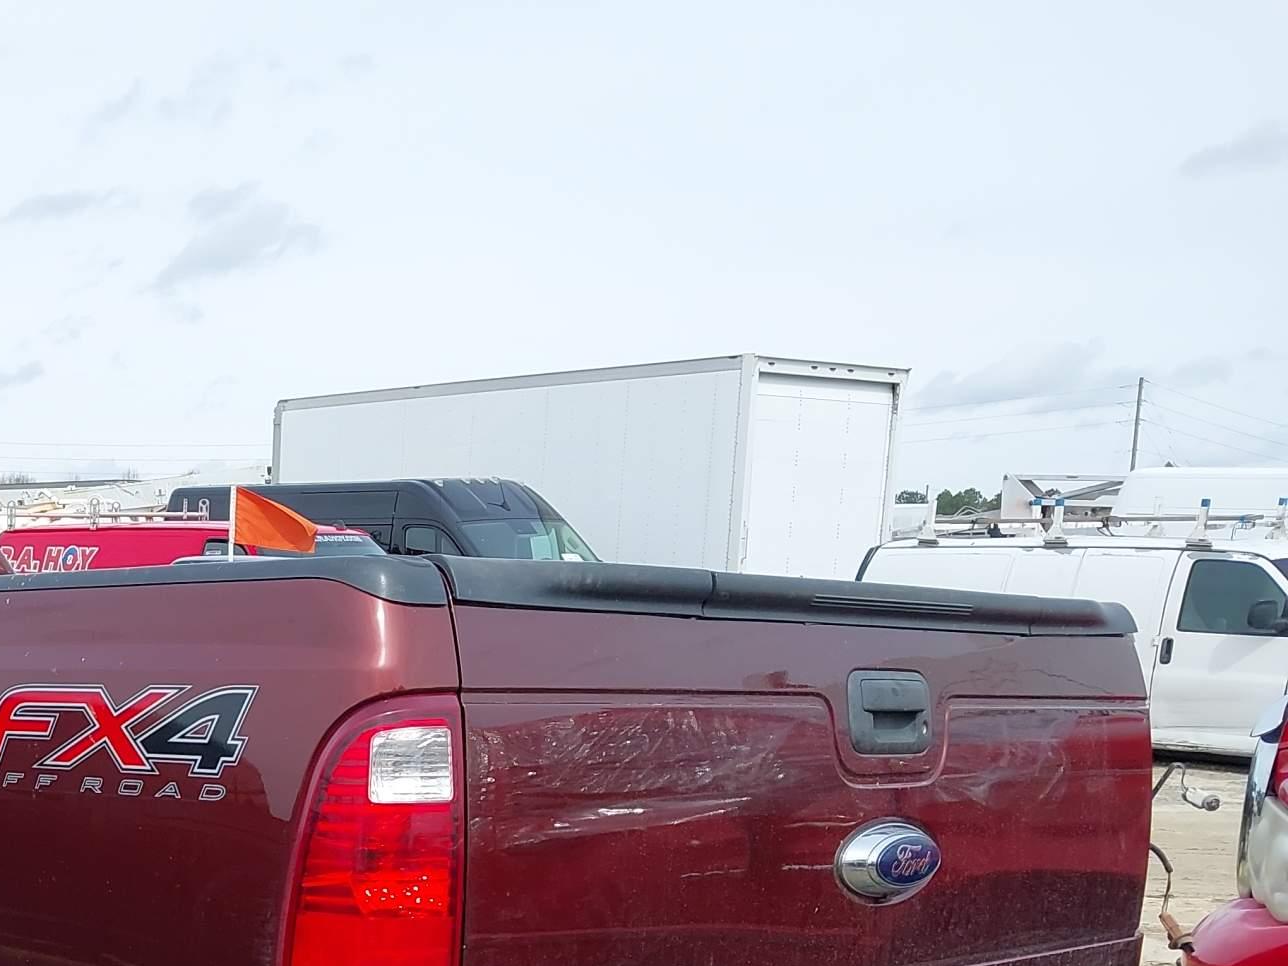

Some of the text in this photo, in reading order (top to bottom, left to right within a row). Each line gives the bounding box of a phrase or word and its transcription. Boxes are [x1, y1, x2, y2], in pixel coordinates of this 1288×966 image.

[41, 545, 99, 572] HOY
[79, 776, 227, 801] ROAD
[892, 844, 931, 877] Ford
